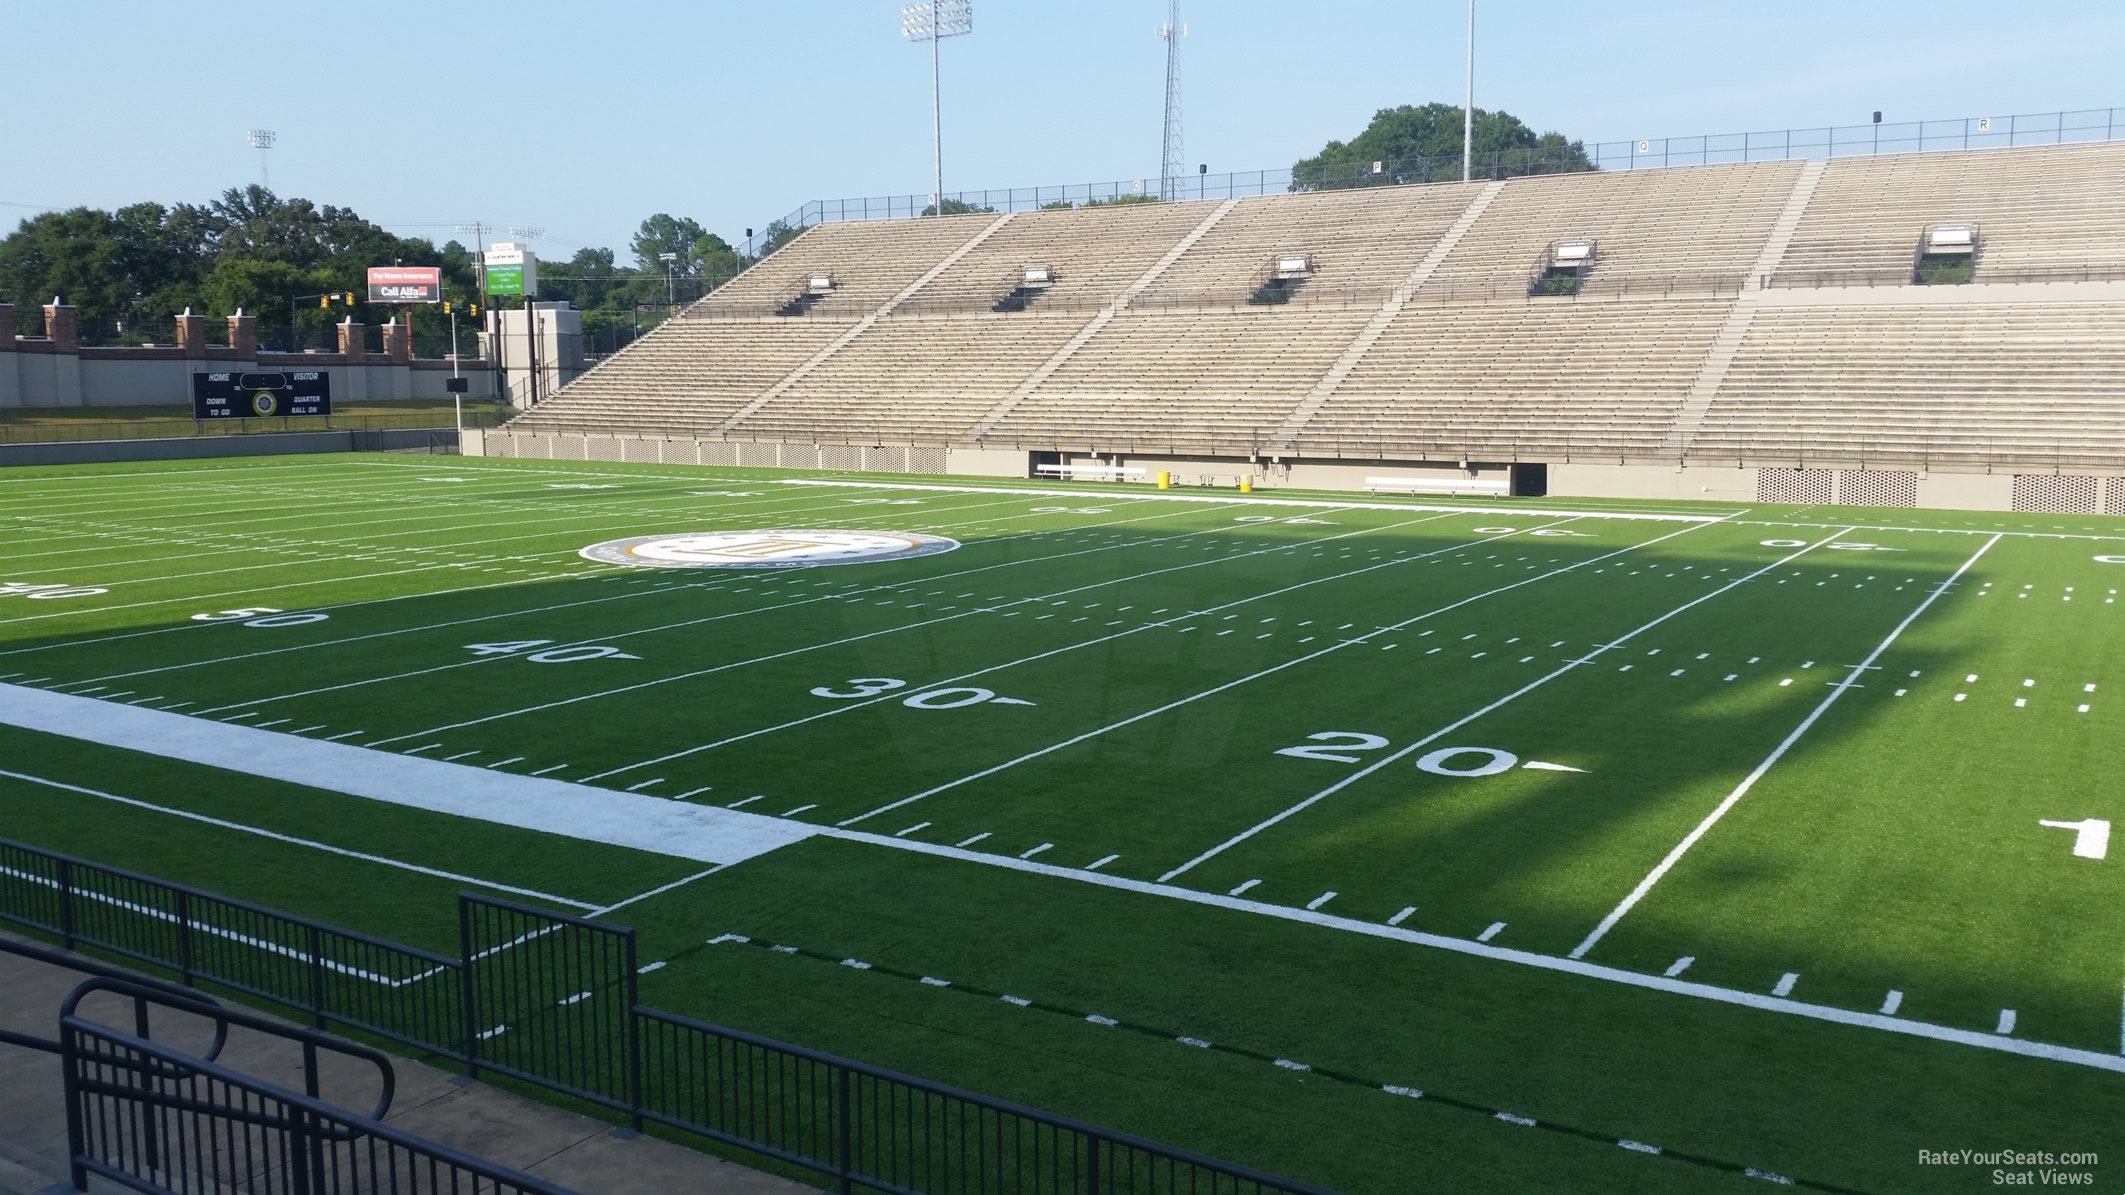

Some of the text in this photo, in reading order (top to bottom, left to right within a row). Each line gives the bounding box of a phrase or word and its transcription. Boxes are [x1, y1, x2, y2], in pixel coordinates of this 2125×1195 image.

[381, 286, 419, 296] Call Alfa
[208, 373, 231, 382] HOME
[293, 372, 319, 381] VISITOR
[206, 397, 227, 405] DOWN
[293, 395, 320, 403] QUARTER
[221, 408, 231, 416] GO
[191, 607, 329, 627] 50
[462, 640, 619, 663] 40
[810, 678, 995, 709] 30
[1273, 731, 1518, 777] 20
